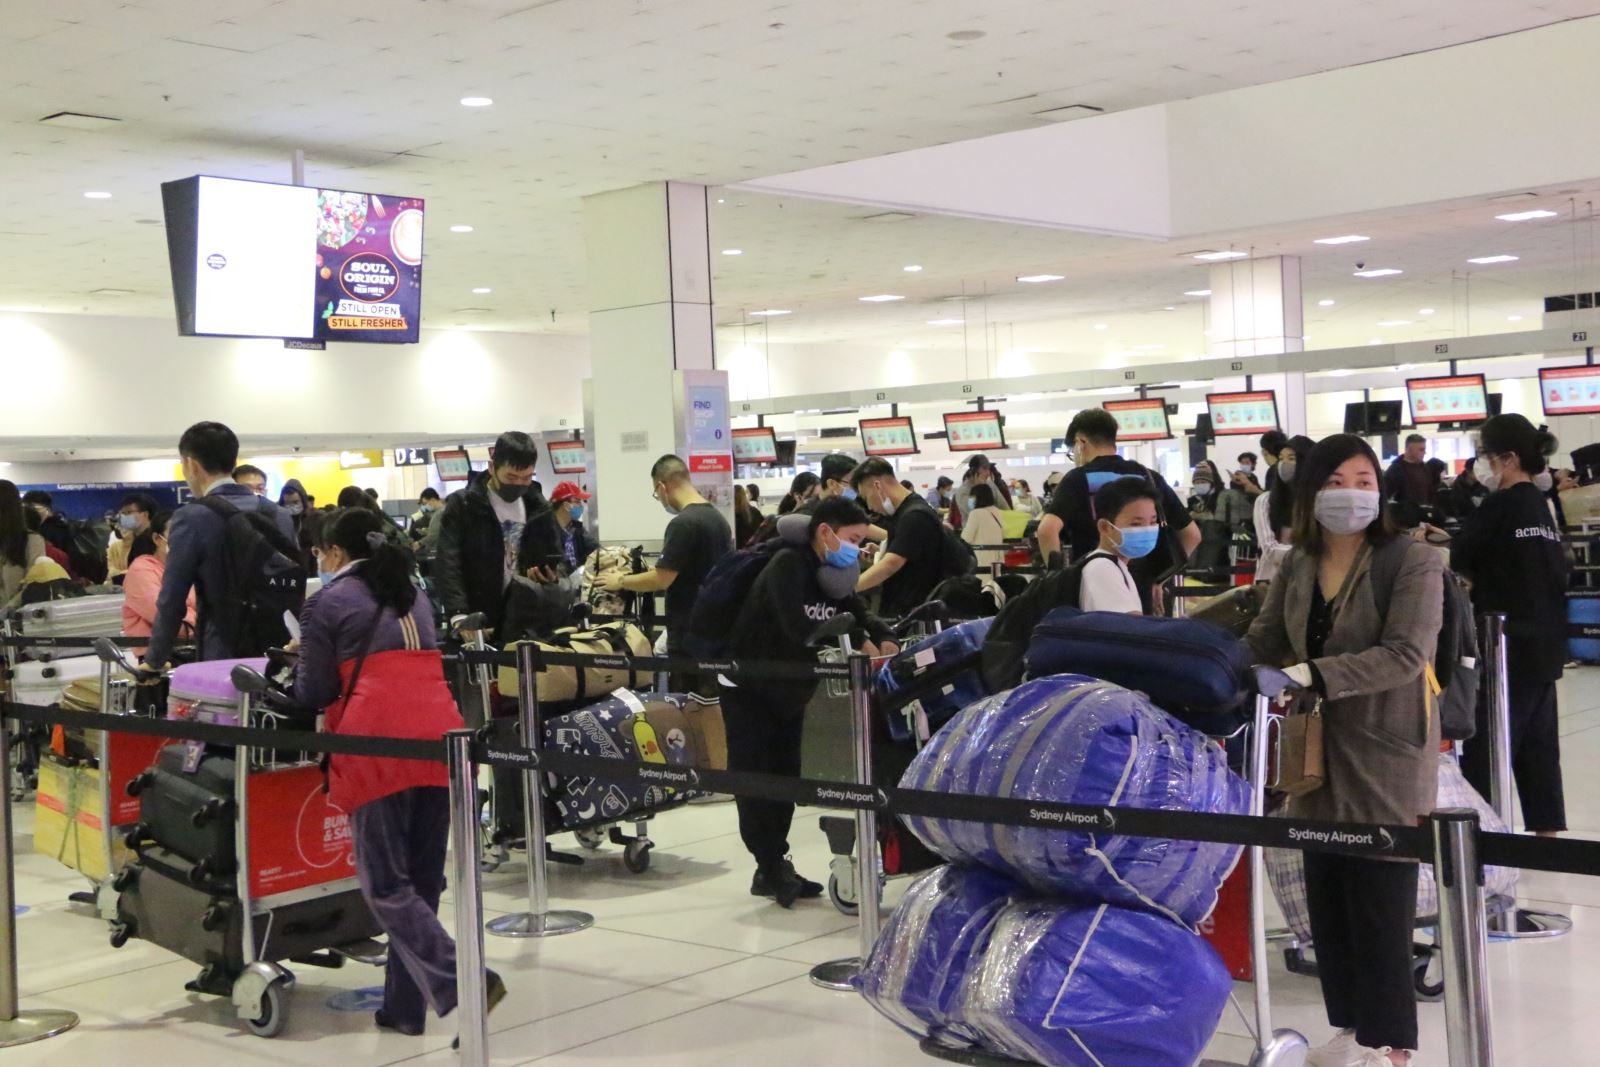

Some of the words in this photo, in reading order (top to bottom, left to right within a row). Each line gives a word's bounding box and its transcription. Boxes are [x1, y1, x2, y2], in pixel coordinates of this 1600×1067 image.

[350, 262, 389, 274] SOUL
[344, 273, 395, 285] ORIGIN
[341, 303, 367, 313] STILL
[370, 305, 397, 315] OPEN
[332, 319, 358, 327] STILL
[360, 319, 403, 327] FRESHER
[1436, 344, 1447, 353] 20
[694, 401, 711, 409] FIND
[269, 577, 297, 588] AIR
[487, 750, 508, 760] Sydney
[508, 751, 529, 762] Airport
[639, 768, 663, 780] Sydney
[663, 771, 687, 781] Airport
[817, 788, 845, 801] Sydney
[845, 791, 874, 802] Airport
[324, 813, 349, 830] BUN
[1030, 809, 1064, 822] Sydney
[1064, 812, 1099, 824] Airport
[333, 826, 353, 840] SA
[1288, 828, 1330, 843] Sydney
[1330, 830, 1373, 844] Airport
